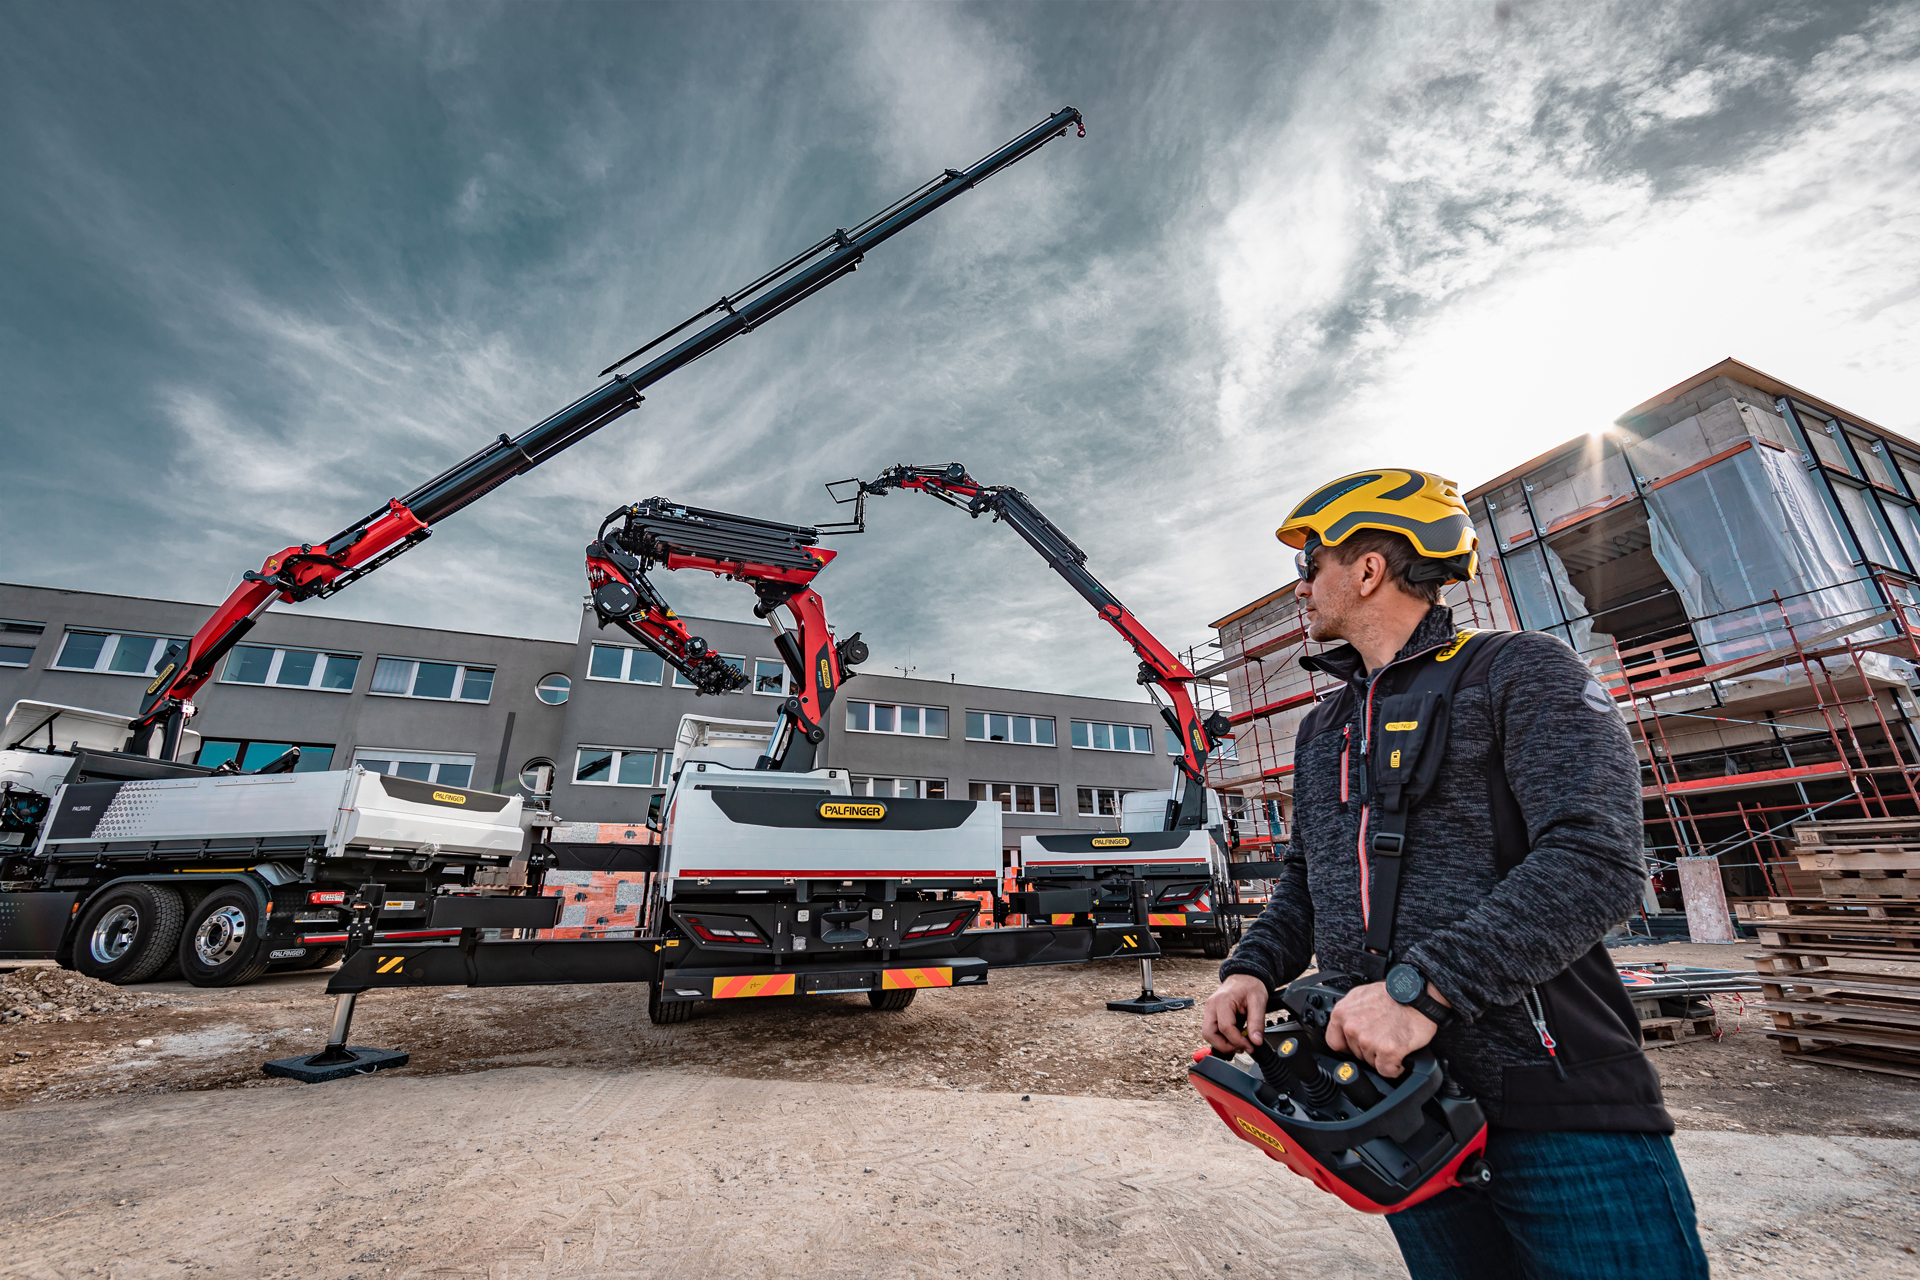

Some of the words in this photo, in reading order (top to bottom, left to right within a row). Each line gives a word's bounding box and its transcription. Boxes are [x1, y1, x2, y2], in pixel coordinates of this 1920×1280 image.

[435, 792, 465, 803] PALFINGER
[824, 805, 881, 817] PALFINGER
[1094, 838, 1128, 846] PALFINGER
[272, 949, 304, 958] PALFINGER
